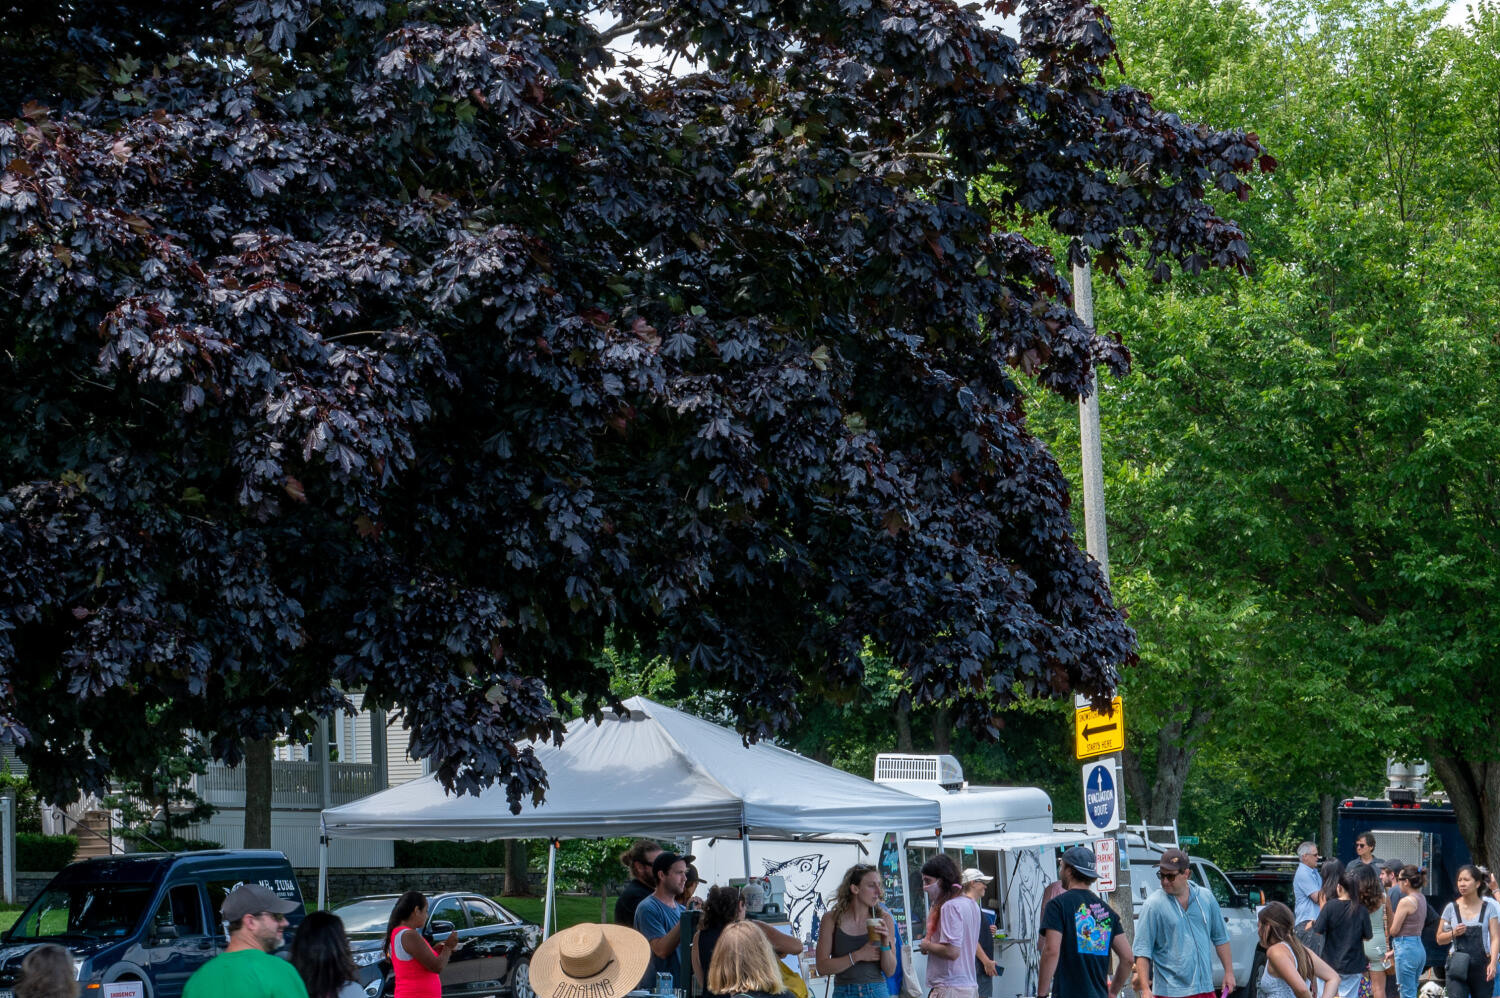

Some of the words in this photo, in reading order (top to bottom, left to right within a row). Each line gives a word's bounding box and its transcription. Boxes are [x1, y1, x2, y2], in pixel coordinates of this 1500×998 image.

[1087, 743, 1100, 752] STARTS
[1101, 740, 1113, 749] HERE
[1088, 790, 1114, 804] EVACUATION
[1094, 804, 1108, 817] ROUTE
[1101, 843, 1109, 852] NO
[1097, 854, 1113, 863] PARKING
[274, 879, 295, 891] TUNA
